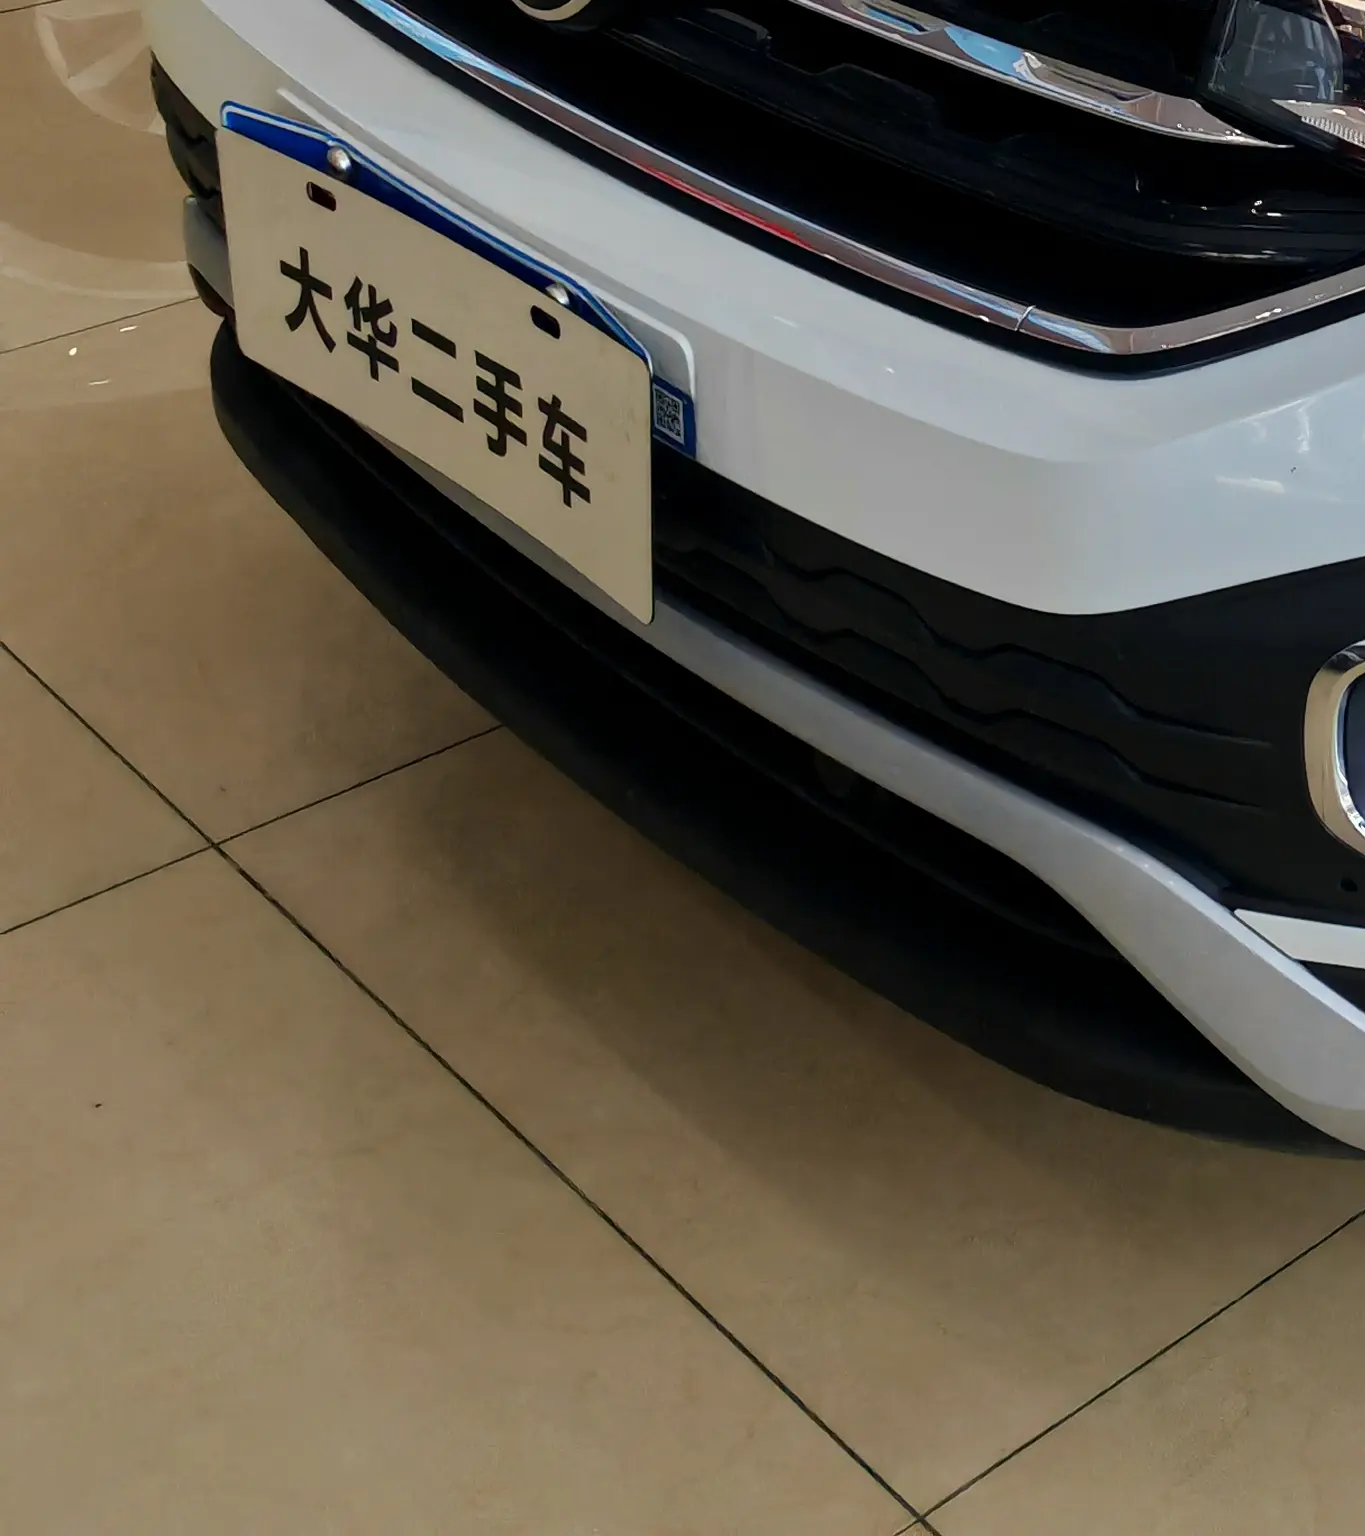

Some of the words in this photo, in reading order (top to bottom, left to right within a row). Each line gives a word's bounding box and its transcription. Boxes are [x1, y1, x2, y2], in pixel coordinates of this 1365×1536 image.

[279, 246, 592, 509] 大华二手车
